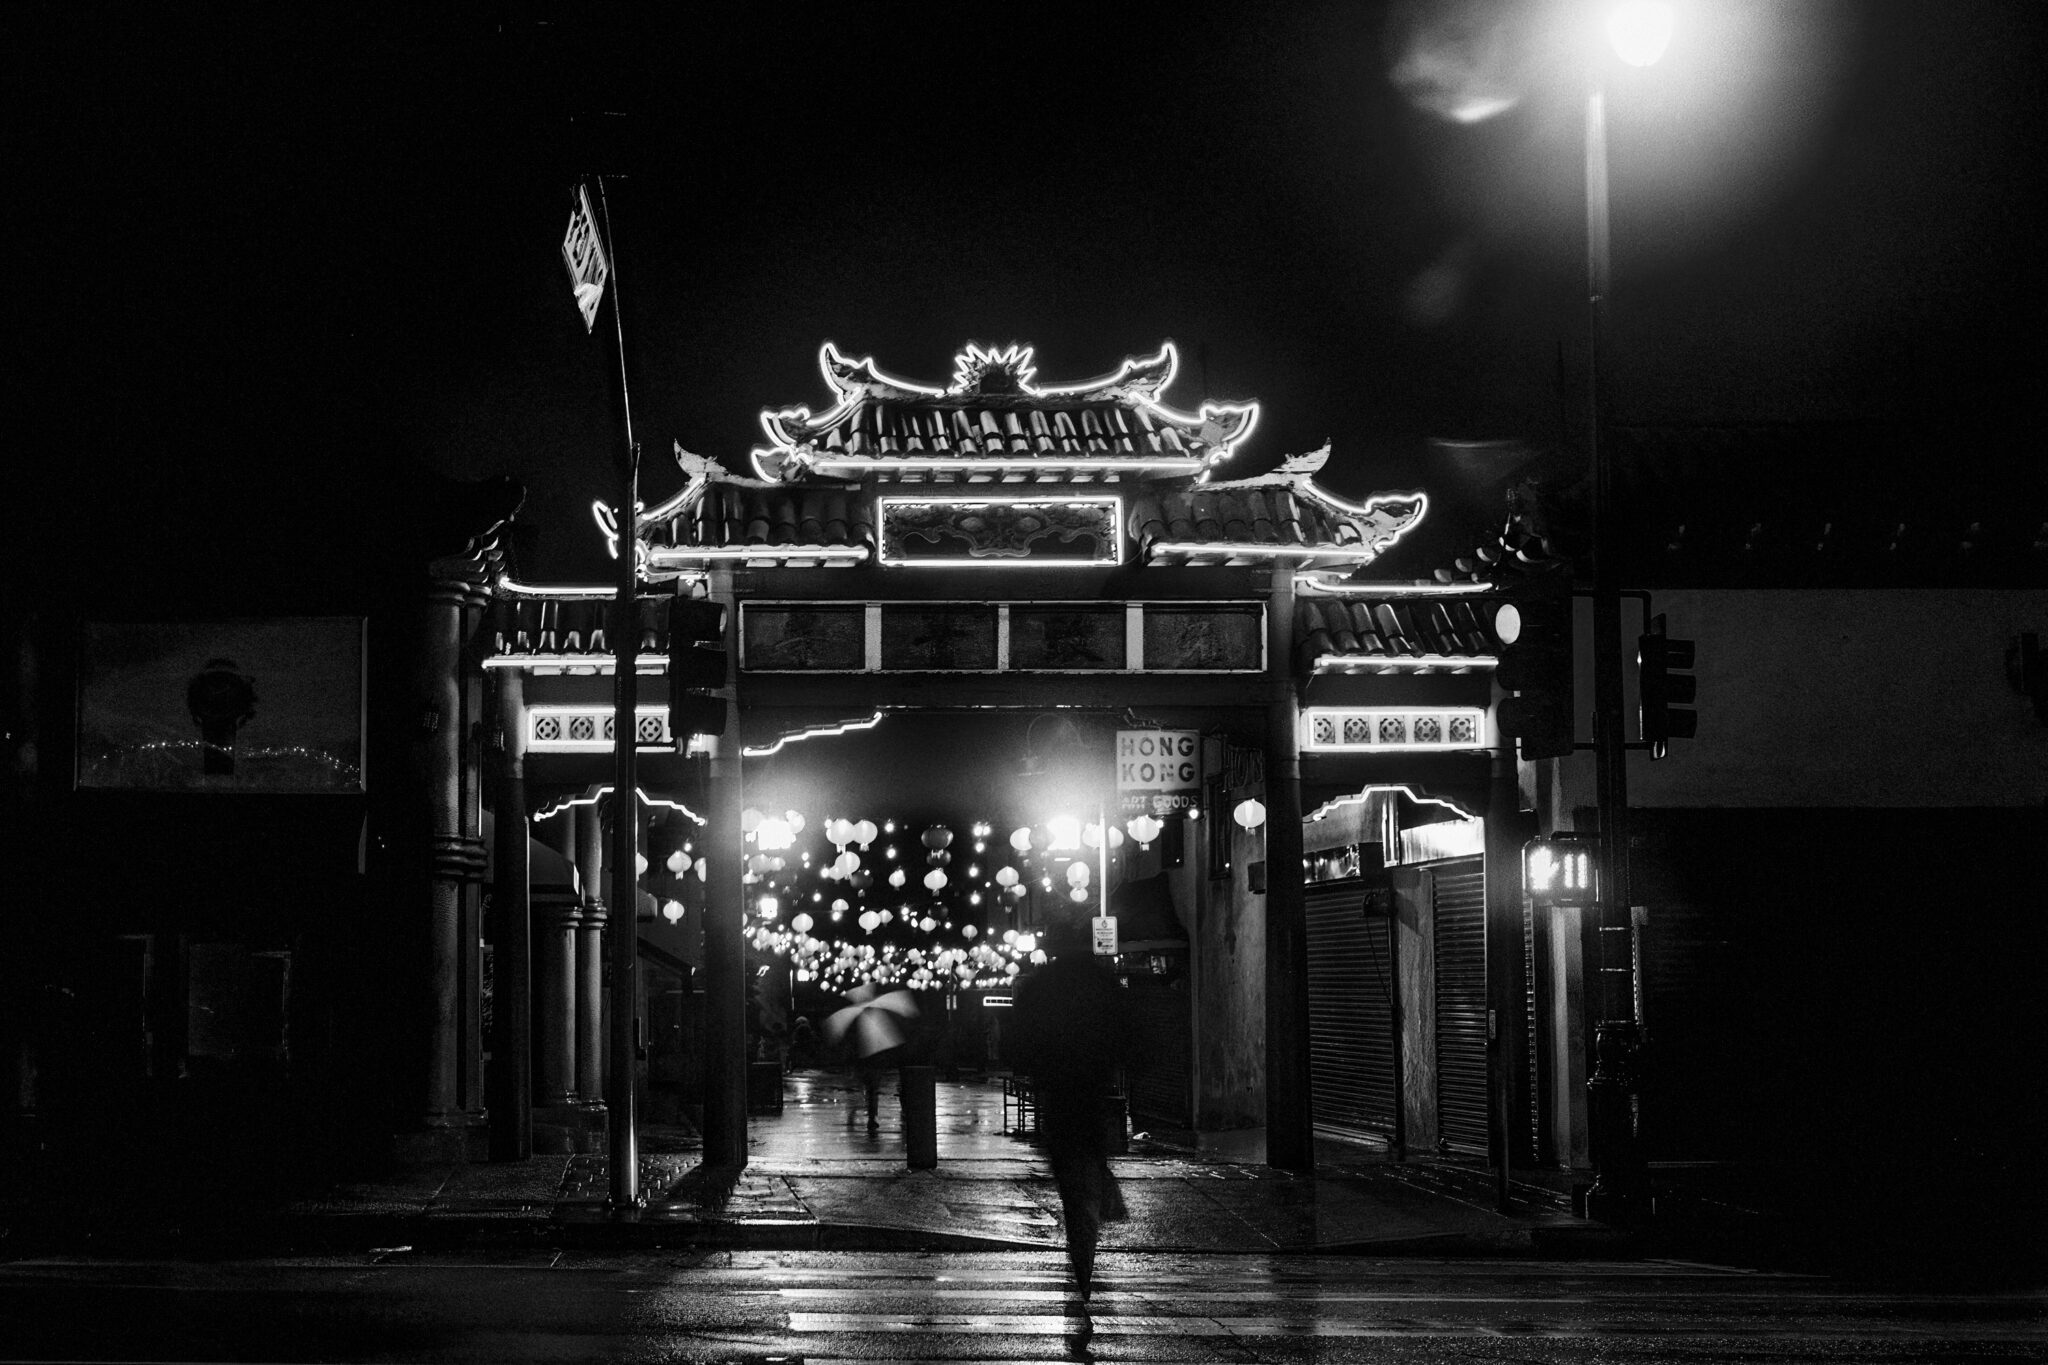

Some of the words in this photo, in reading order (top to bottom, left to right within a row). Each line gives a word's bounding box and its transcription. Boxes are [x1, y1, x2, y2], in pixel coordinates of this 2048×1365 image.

[1122, 737, 1194, 757] HONG
[1122, 763, 1196, 783] KONG
[1152, 795, 1198, 809] GOODS
